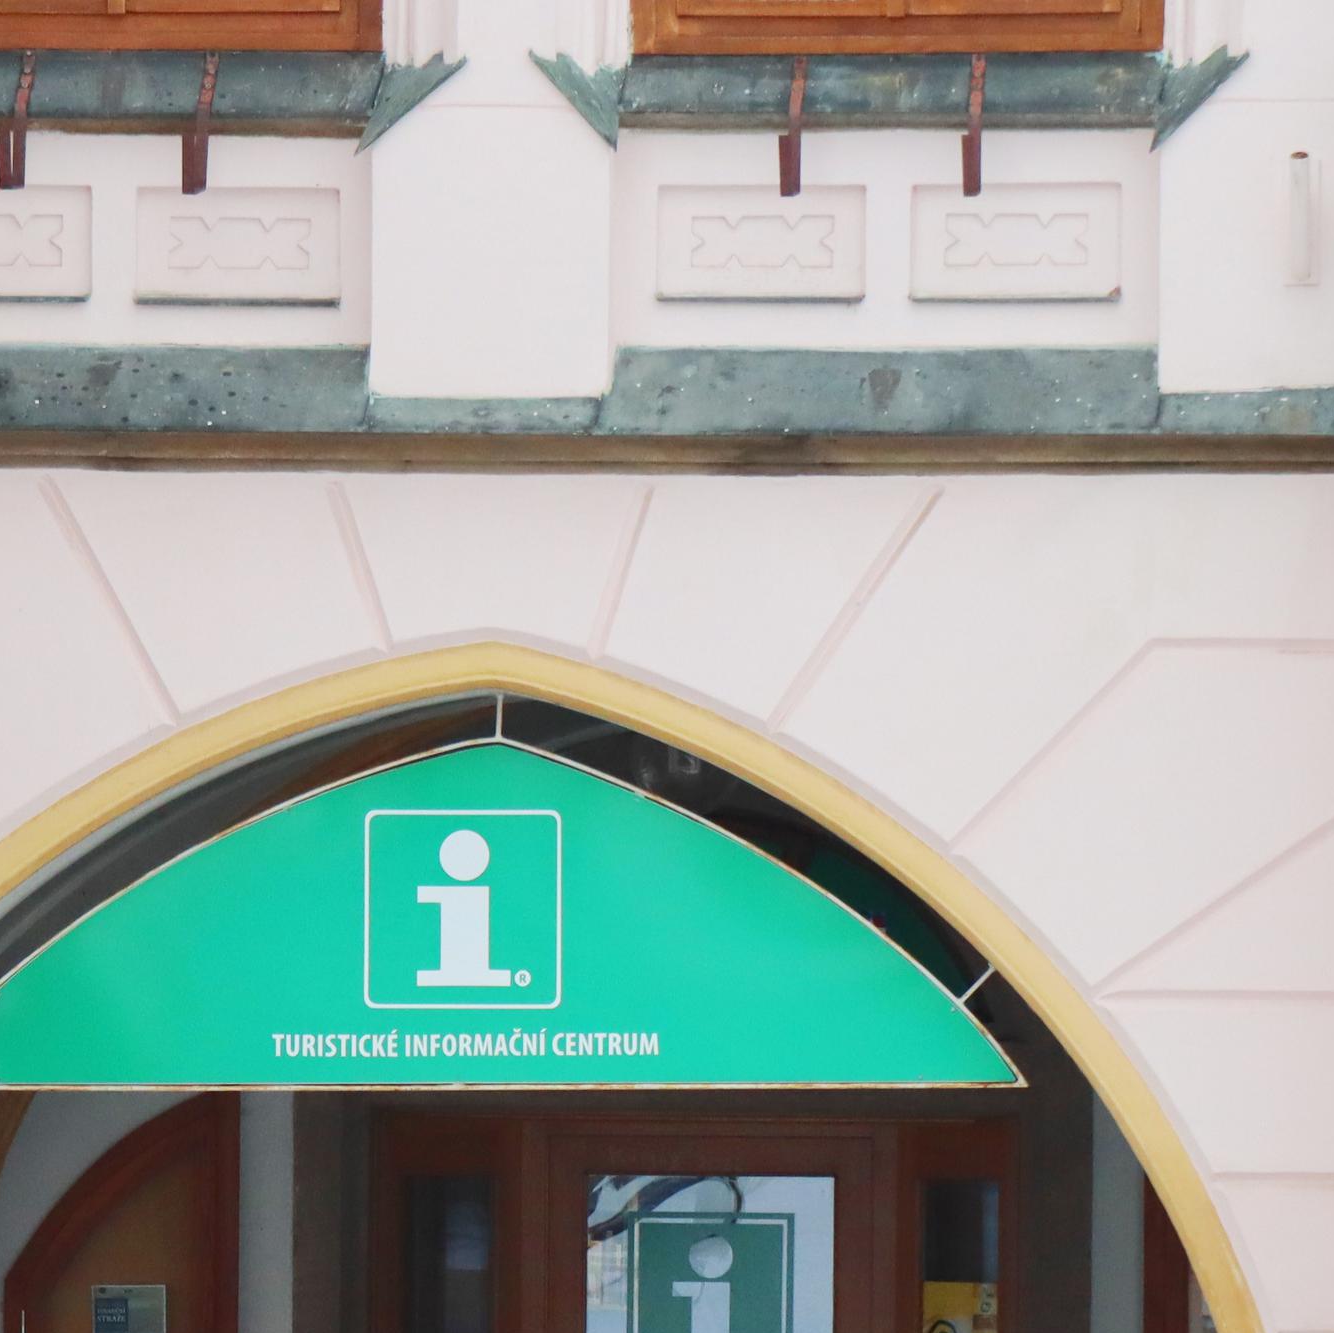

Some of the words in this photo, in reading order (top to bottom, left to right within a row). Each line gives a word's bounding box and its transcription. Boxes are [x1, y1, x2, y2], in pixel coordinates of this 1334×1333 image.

[416, 829, 512, 987] i
[271, 1029, 399, 1058] TURISTICKÉ
[403, 1028, 547, 1058] INFORMAČNÍ
[551, 1032, 660, 1057] CENTRUM
